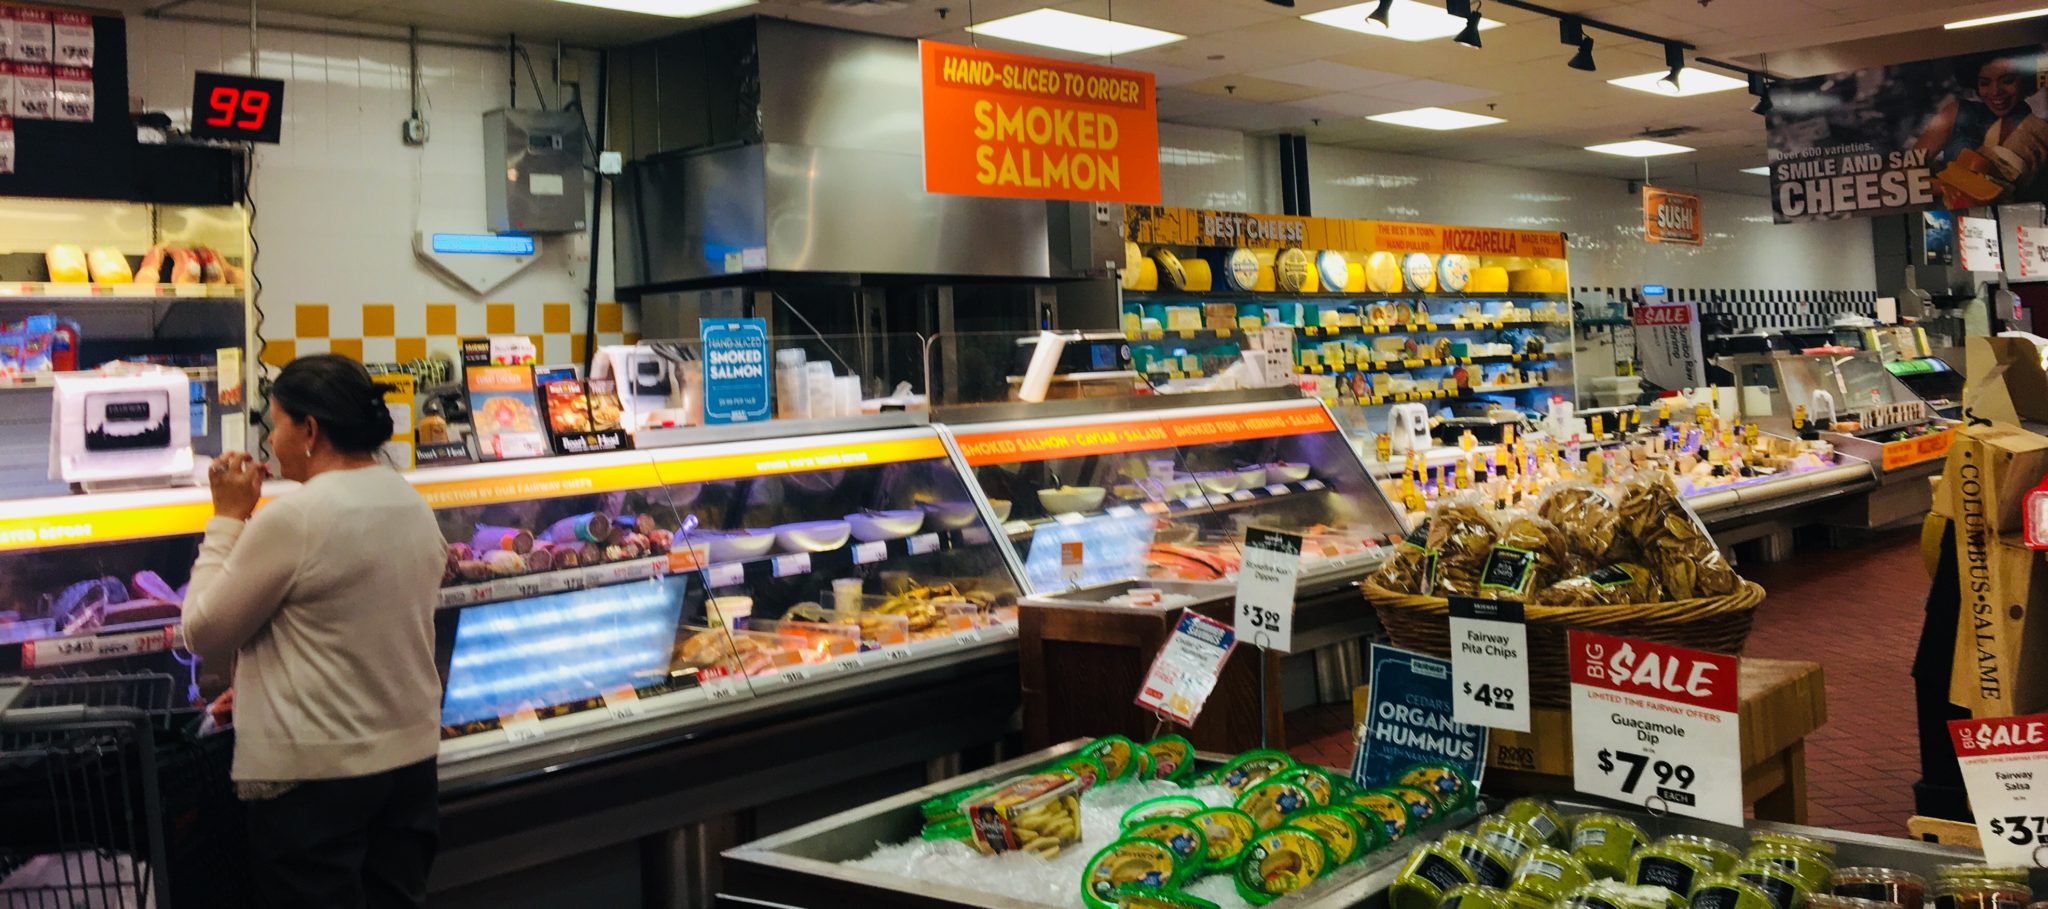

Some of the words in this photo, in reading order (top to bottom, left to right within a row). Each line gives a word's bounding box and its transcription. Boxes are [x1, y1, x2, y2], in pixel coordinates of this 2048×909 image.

[943, 56, 1060, 94] HAND-SLICED
[1064, 72, 1084, 97] TO
[1087, 78, 1139, 103] ORDER
[206, 86, 270, 130] 99
[974, 99, 1119, 150] SMOKED
[1777, 149, 1799, 161] Over
[1801, 147, 1822, 158] 600
[1824, 142, 1874, 156] varieties.
[1778, 159, 1836, 181] SMILE
[1841, 153, 1883, 174] AND
[1889, 148, 1929, 168] SAY
[976, 145, 1121, 192] SALMON
[1779, 167, 1934, 218] CHEESE
[1204, 215, 1242, 239] BEST
[1247, 218, 1303, 241] CHEESE
[1657, 204, 1693, 230] SUSHI
[1442, 229, 1516, 254] MOZZARELLA
[710, 349, 762, 364] SMOKED
[710, 364, 763, 380] SALMON
[1173, 421, 1216, 438] SMOKED
[1217, 419, 1238, 434] FISH
[1290, 412, 1325, 427] SALADS
[960, 438, 1017, 457] SMOKED
[1019, 434, 1068, 453] SALMON
[1076, 431, 1118, 448] CAVIAR
[1126, 427, 1167, 443] SALADS
[517, 481, 559, 495] FAIRWAY
[1960, 464, 1991, 595] COLUMBUS
[1462, 642, 1482, 655] Pita
[1485, 645, 1517, 659] Chips
[1467, 630, 1509, 646] Fairway
[1973, 600, 2001, 701] SALAME
[1585, 643, 1605, 679] BIG
[1378, 701, 1477, 738] ORGANIC
[1587, 690, 1622, 704] LIMITED
[1624, 696, 1645, 708] TIME
[1647, 699, 1683, 716] FAIRWAY
[1686, 707, 1721, 723] OFFERS
[1611, 713, 1685, 737] Guacamole
[1637, 730, 1660, 745] Dip
[1376, 722, 1475, 761] HUMMUS
[1959, 728, 1976, 749] BIG
[1995, 771, 2033, 781] Fairway
[2005, 782, 2031, 791] Salsa
[1663, 792, 1689, 803] EACH
